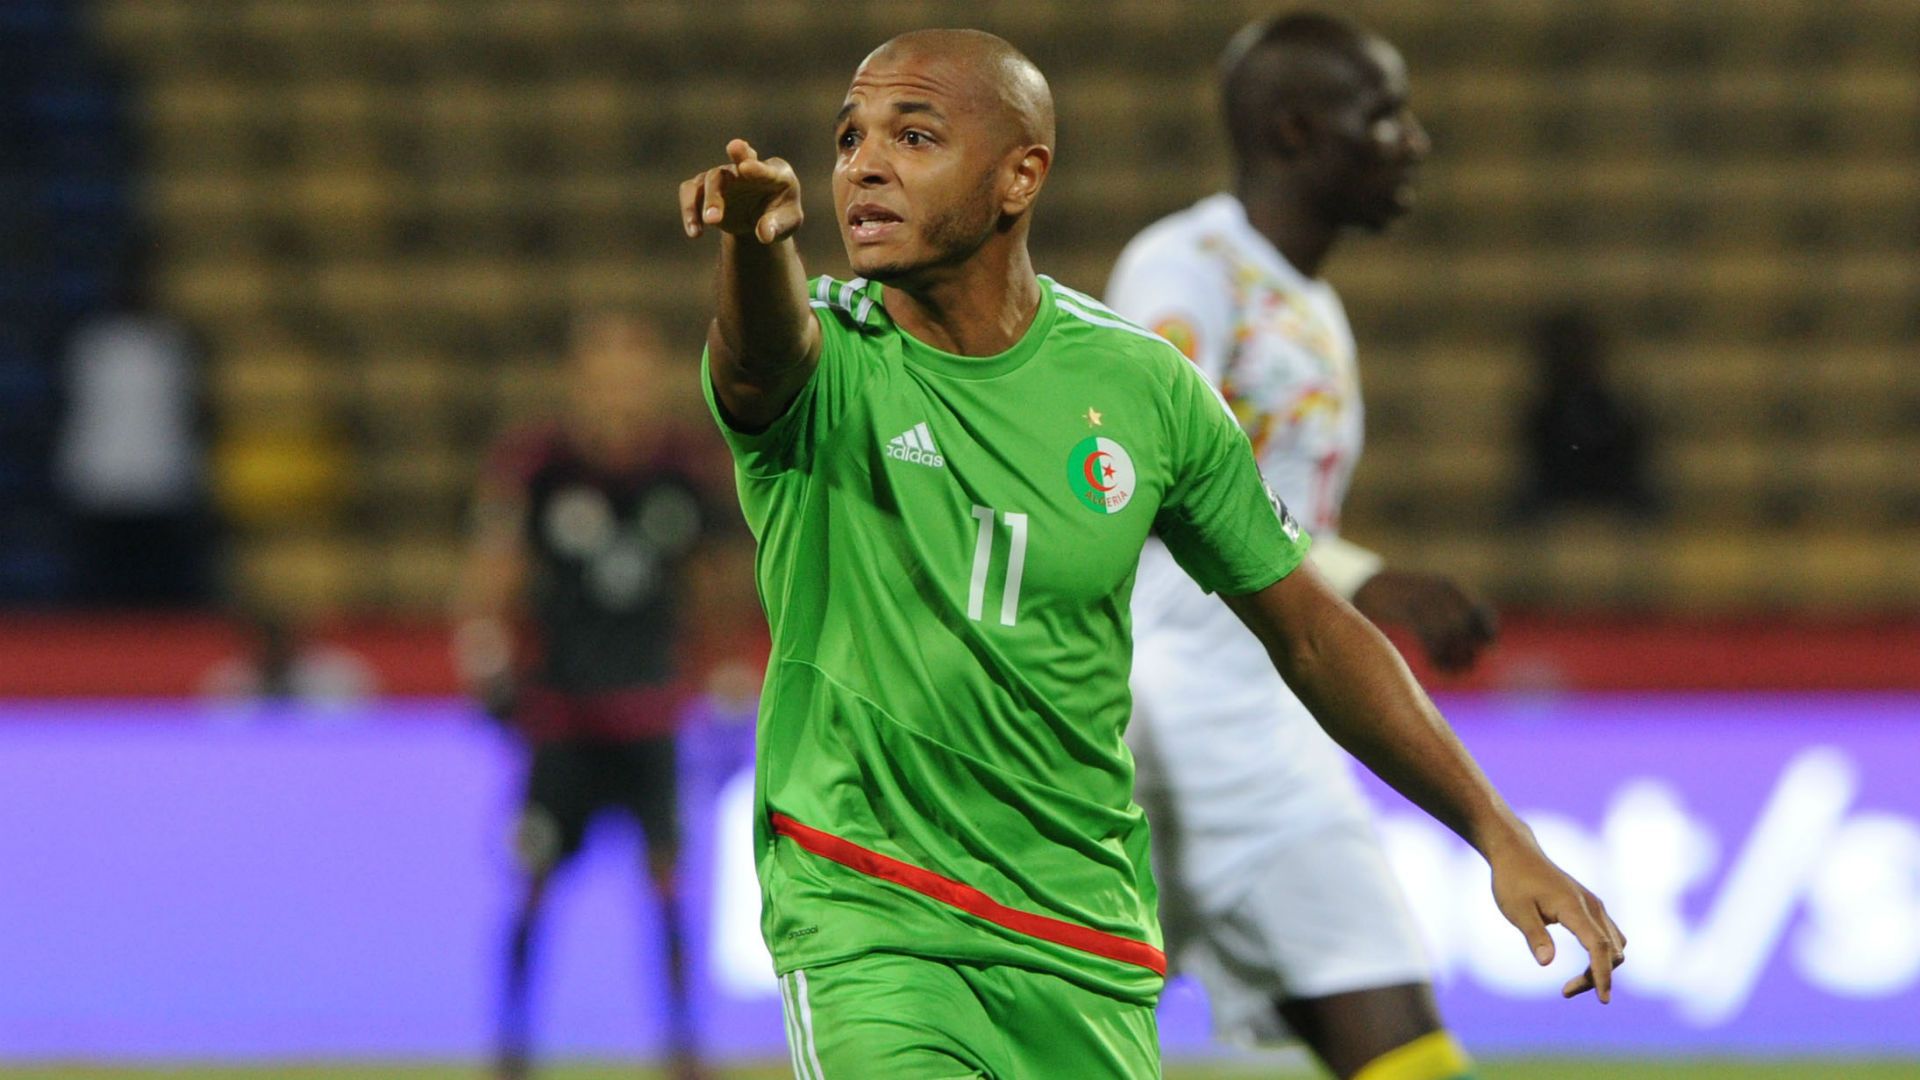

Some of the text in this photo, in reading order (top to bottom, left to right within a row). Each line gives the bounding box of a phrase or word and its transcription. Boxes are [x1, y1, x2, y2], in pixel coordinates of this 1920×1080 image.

[886, 443, 945, 468] adidas
[1085, 490, 1129, 508] ALGERIA
[967, 503, 1028, 627] 11
